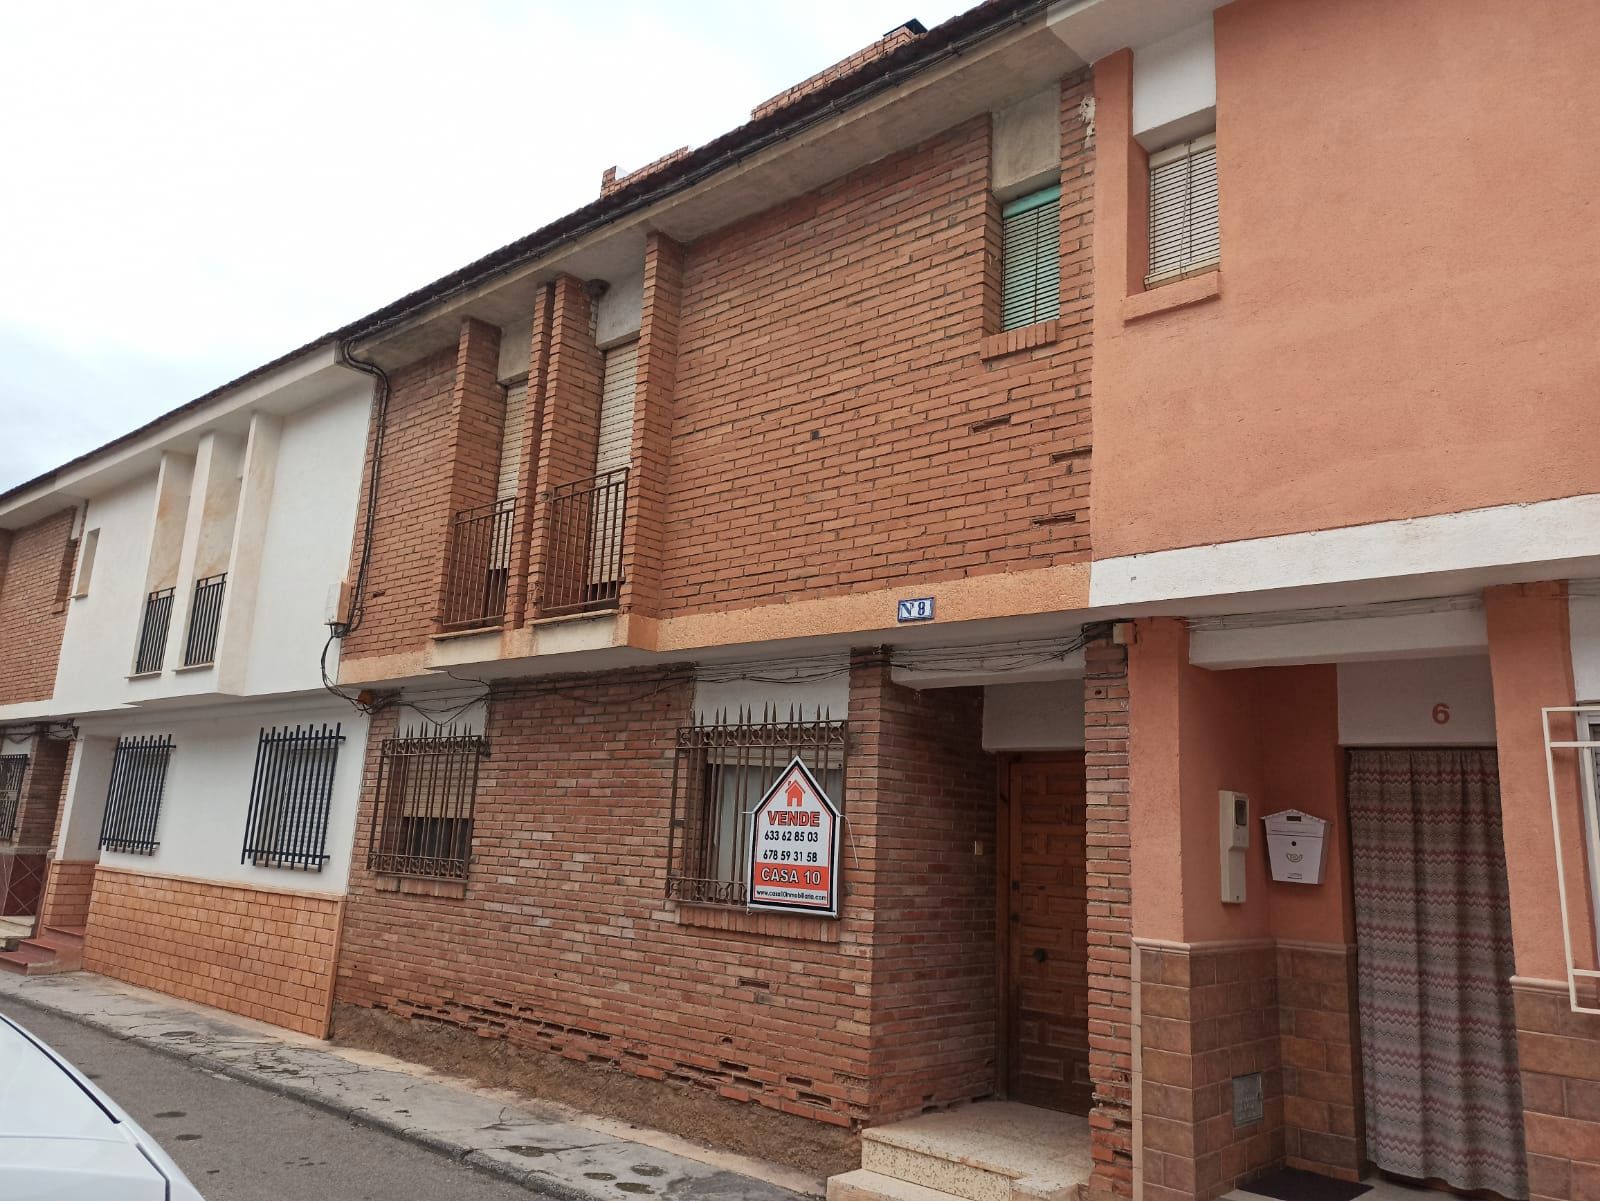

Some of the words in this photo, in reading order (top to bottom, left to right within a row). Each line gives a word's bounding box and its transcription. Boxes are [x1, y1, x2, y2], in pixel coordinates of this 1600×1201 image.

[918, 601, 925, 616] 8
[1432, 703, 1450, 725] 6
[767, 810, 821, 827] VENDE
[764, 830, 780, 841] 633
[781, 831, 792, 842] 62
[794, 831, 805, 842] 85
[807, 832, 819, 843] 03
[763, 849, 778, 861] 678
[780, 850, 791, 861] 59
[793, 851, 803, 862] 31
[806, 851, 818, 863] 58
[761, 867, 799, 883] CASA
[804, 869, 821, 885] 10
